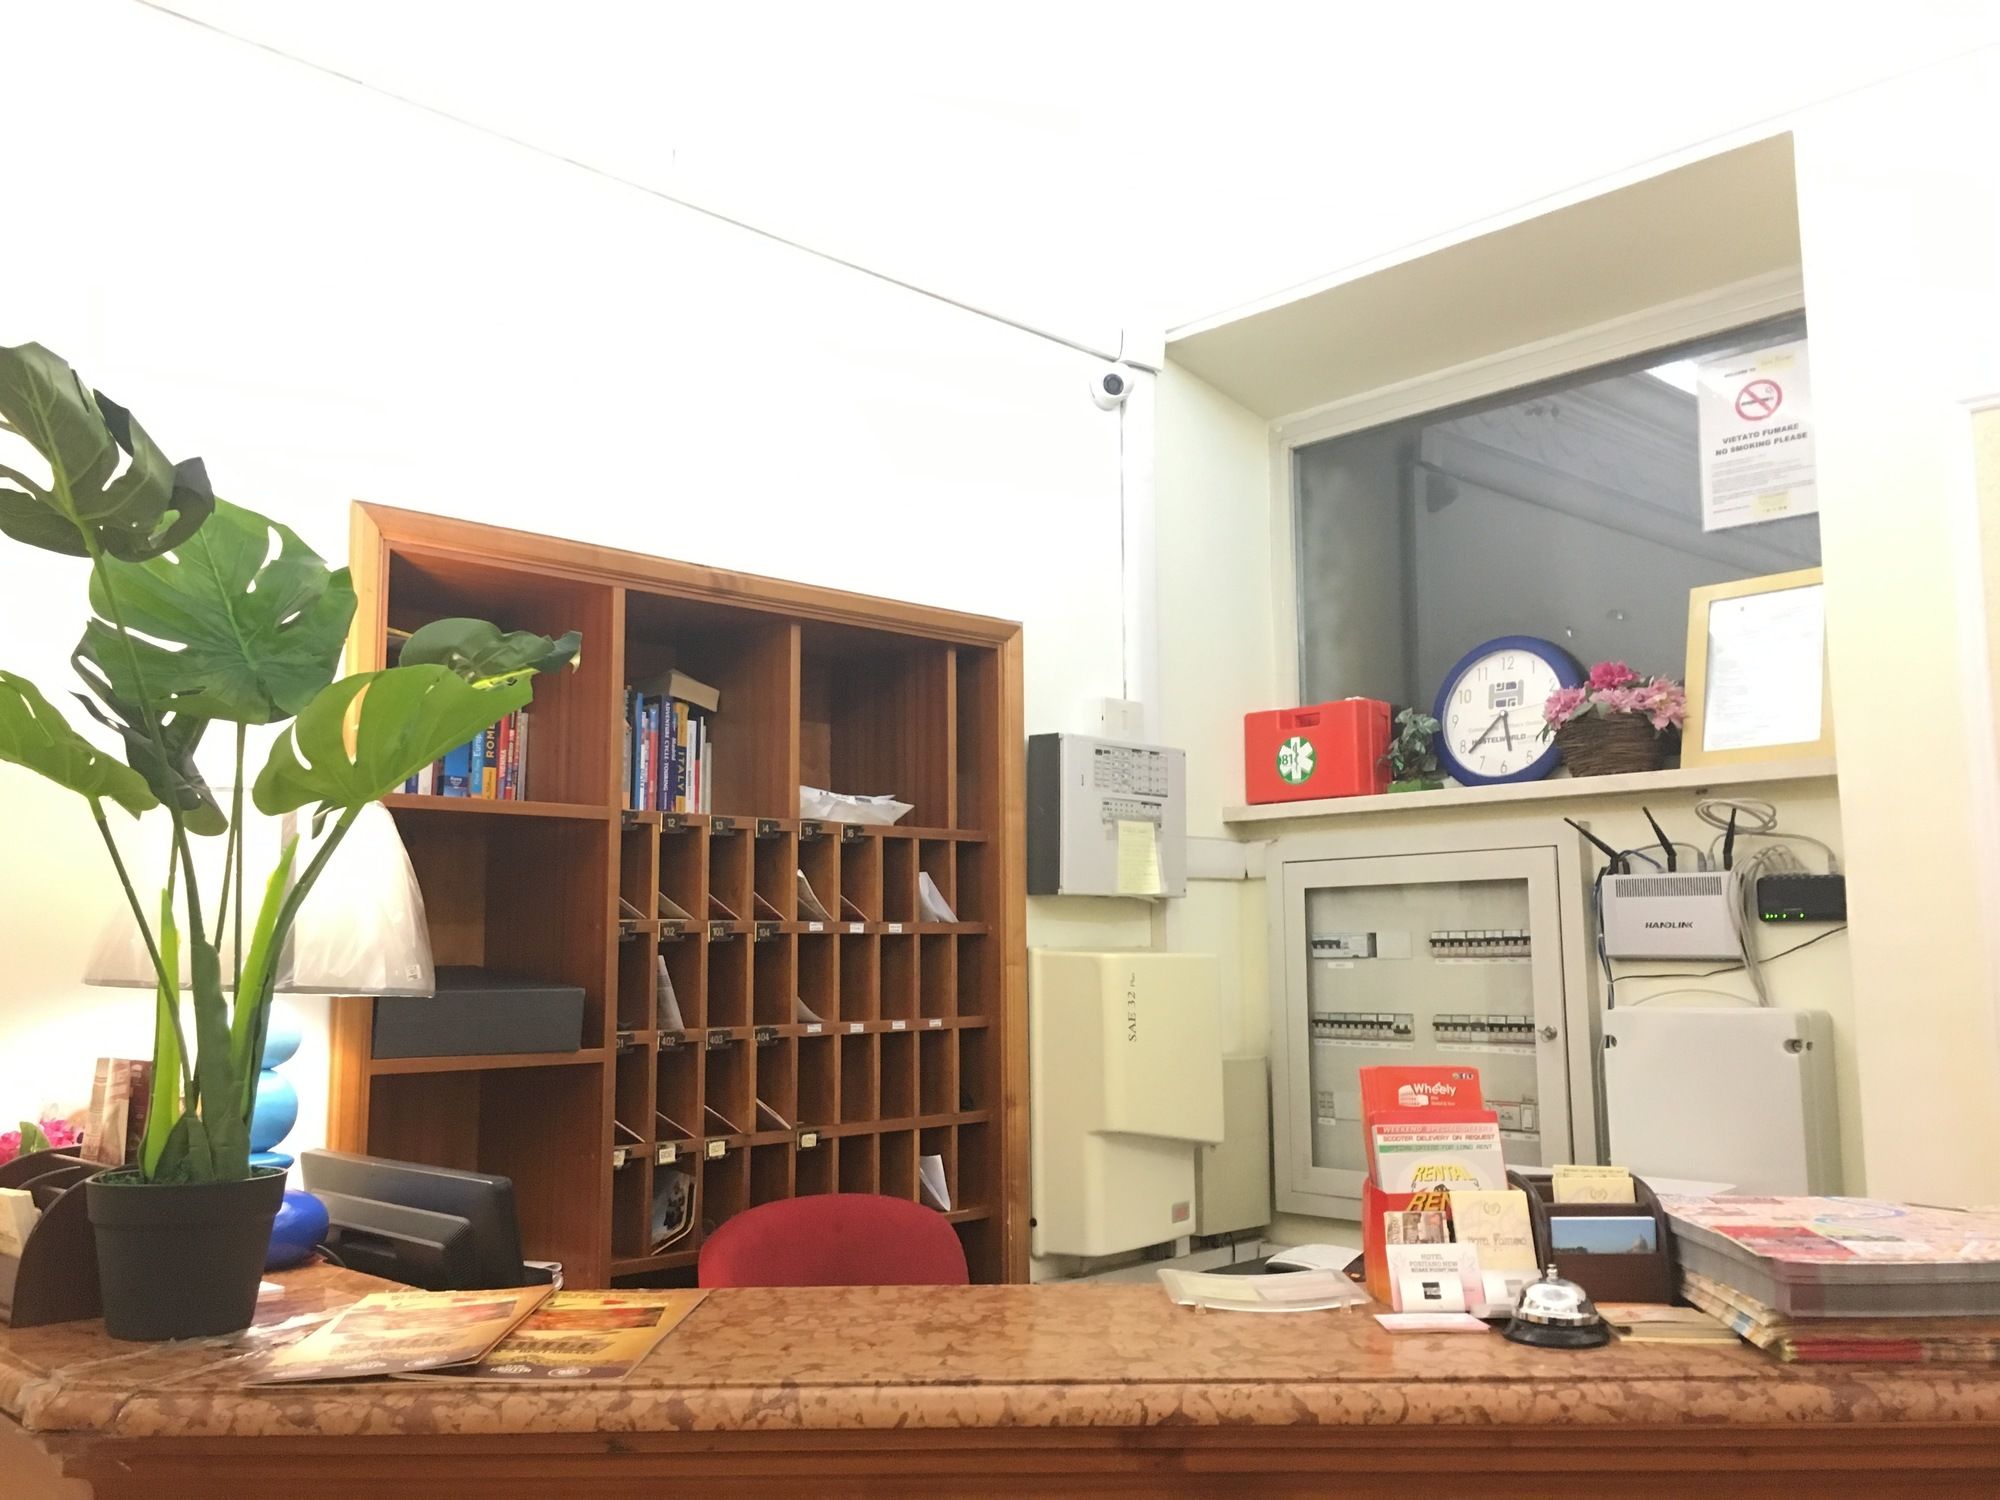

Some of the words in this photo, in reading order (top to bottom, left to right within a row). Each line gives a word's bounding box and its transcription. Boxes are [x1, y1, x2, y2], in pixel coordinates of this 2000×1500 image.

[1722, 431, 1760, 444] VIETATO
[1762, 423, 1799, 436] FUMARE
[1730, 439, 1771, 453] SMOKING
[1773, 432, 1808, 445] PLEASE
[1501, 656, 1514, 671] 12
[1531, 660, 1535, 674] 1
[1477, 667, 1488, 682] 11
[1458, 689, 1472, 704] 10
[1452, 714, 1459, 728] 9
[473, 734, 482, 757] Europ
[1472, 733, 1526, 745] HSTELWRLD
[1460, 739, 1467, 755] 8
[1479, 756, 1485, 769] 7
[1526, 750, 1533, 764] 5
[677, 751, 685, 791] ITALY
[1500, 760, 1507, 774] 6
[667, 818, 676, 828] 12
[715, 821, 723, 830] 13
[762, 824, 769, 833] 14
[805, 827, 813, 836] 15
[712, 928, 724, 936] 103
[1645, 921, 1693, 929] HANDLINK
[663, 928, 675, 937] 102
[759, 928, 770, 937] 104
[1128, 991, 1136, 1007] 32
[1128, 1012, 1136, 1042] SAE
[616, 1039, 624, 1048] 01
[661, 1037, 675, 1046] 402
[709, 1035, 723, 1044] 403
[757, 1032, 770, 1041] 404
[1413, 1082, 1456, 1097] Wheely
